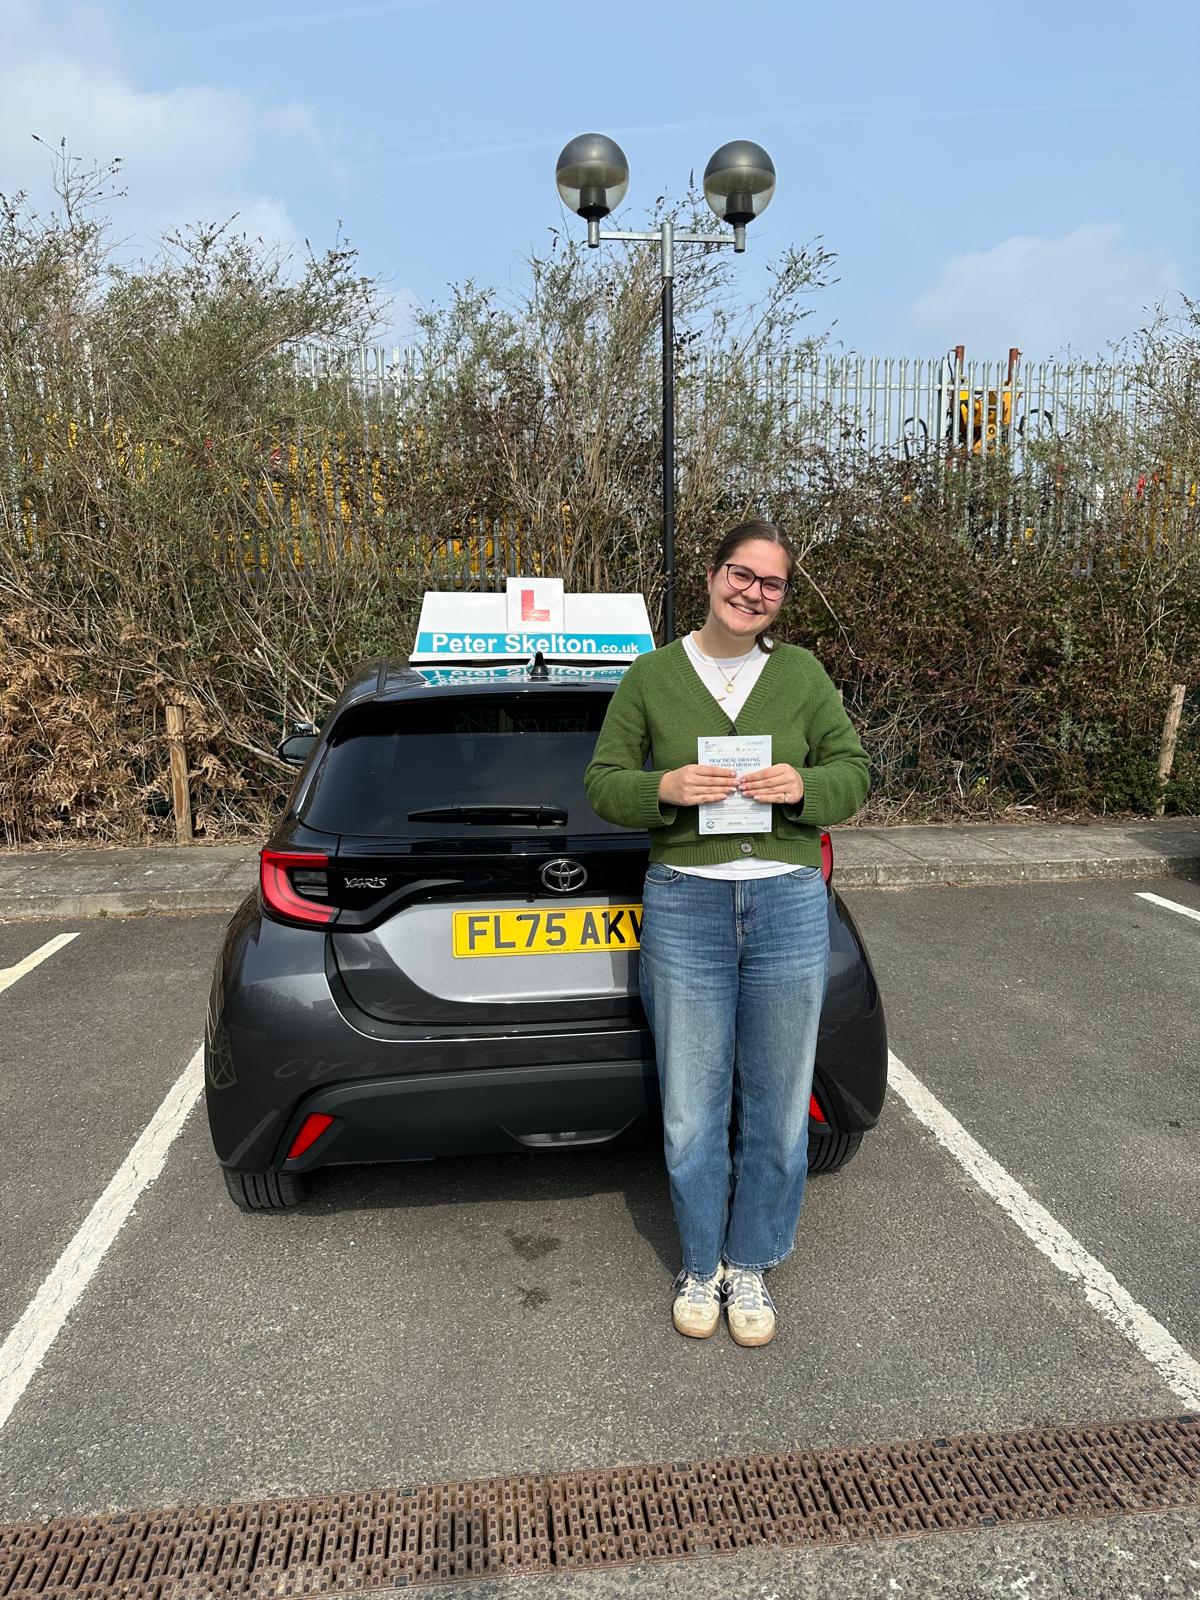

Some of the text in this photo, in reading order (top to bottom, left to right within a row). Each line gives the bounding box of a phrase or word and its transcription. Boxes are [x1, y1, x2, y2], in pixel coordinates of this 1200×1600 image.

[521, 589, 550, 622] L
[432, 634, 639, 654] Peter Skelton.co.uk
[468, 913, 566, 949] FL75
